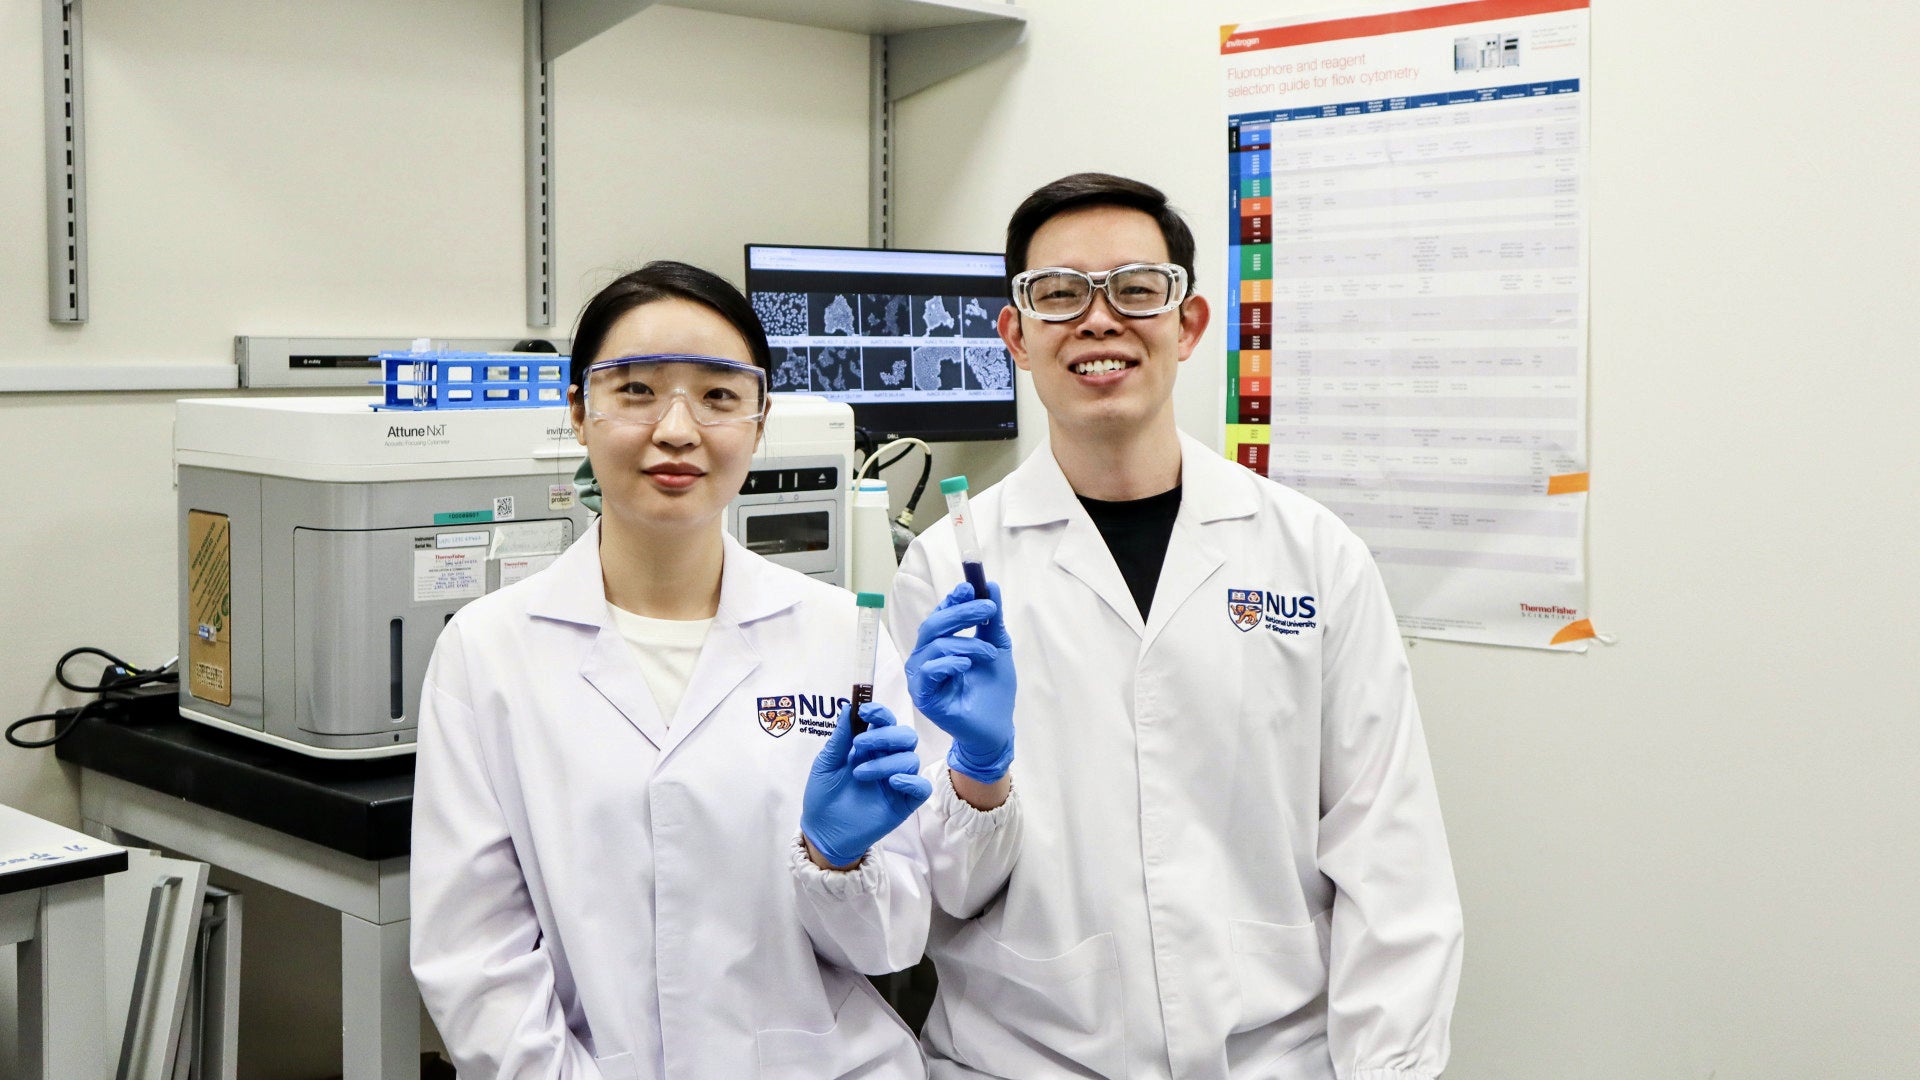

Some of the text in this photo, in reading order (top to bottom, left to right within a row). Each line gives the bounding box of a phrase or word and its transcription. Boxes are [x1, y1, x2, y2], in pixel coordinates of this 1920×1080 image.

[1226, 38, 1260, 48] invitrogen
[1227, 54, 1366, 80] Fluorophore and reagent
[1228, 67, 1420, 97] selection guide for flow cytometry
[387, 424, 447, 437] Attune NxT
[1266, 592, 1316, 618] NUS
[1520, 603, 1576, 614] ThermoFisher
[1265, 615, 1316, 628] National University
[1272, 624, 1300, 635] Singapore
[799, 718, 825, 728] National
[808, 727, 832, 737] Singapo
